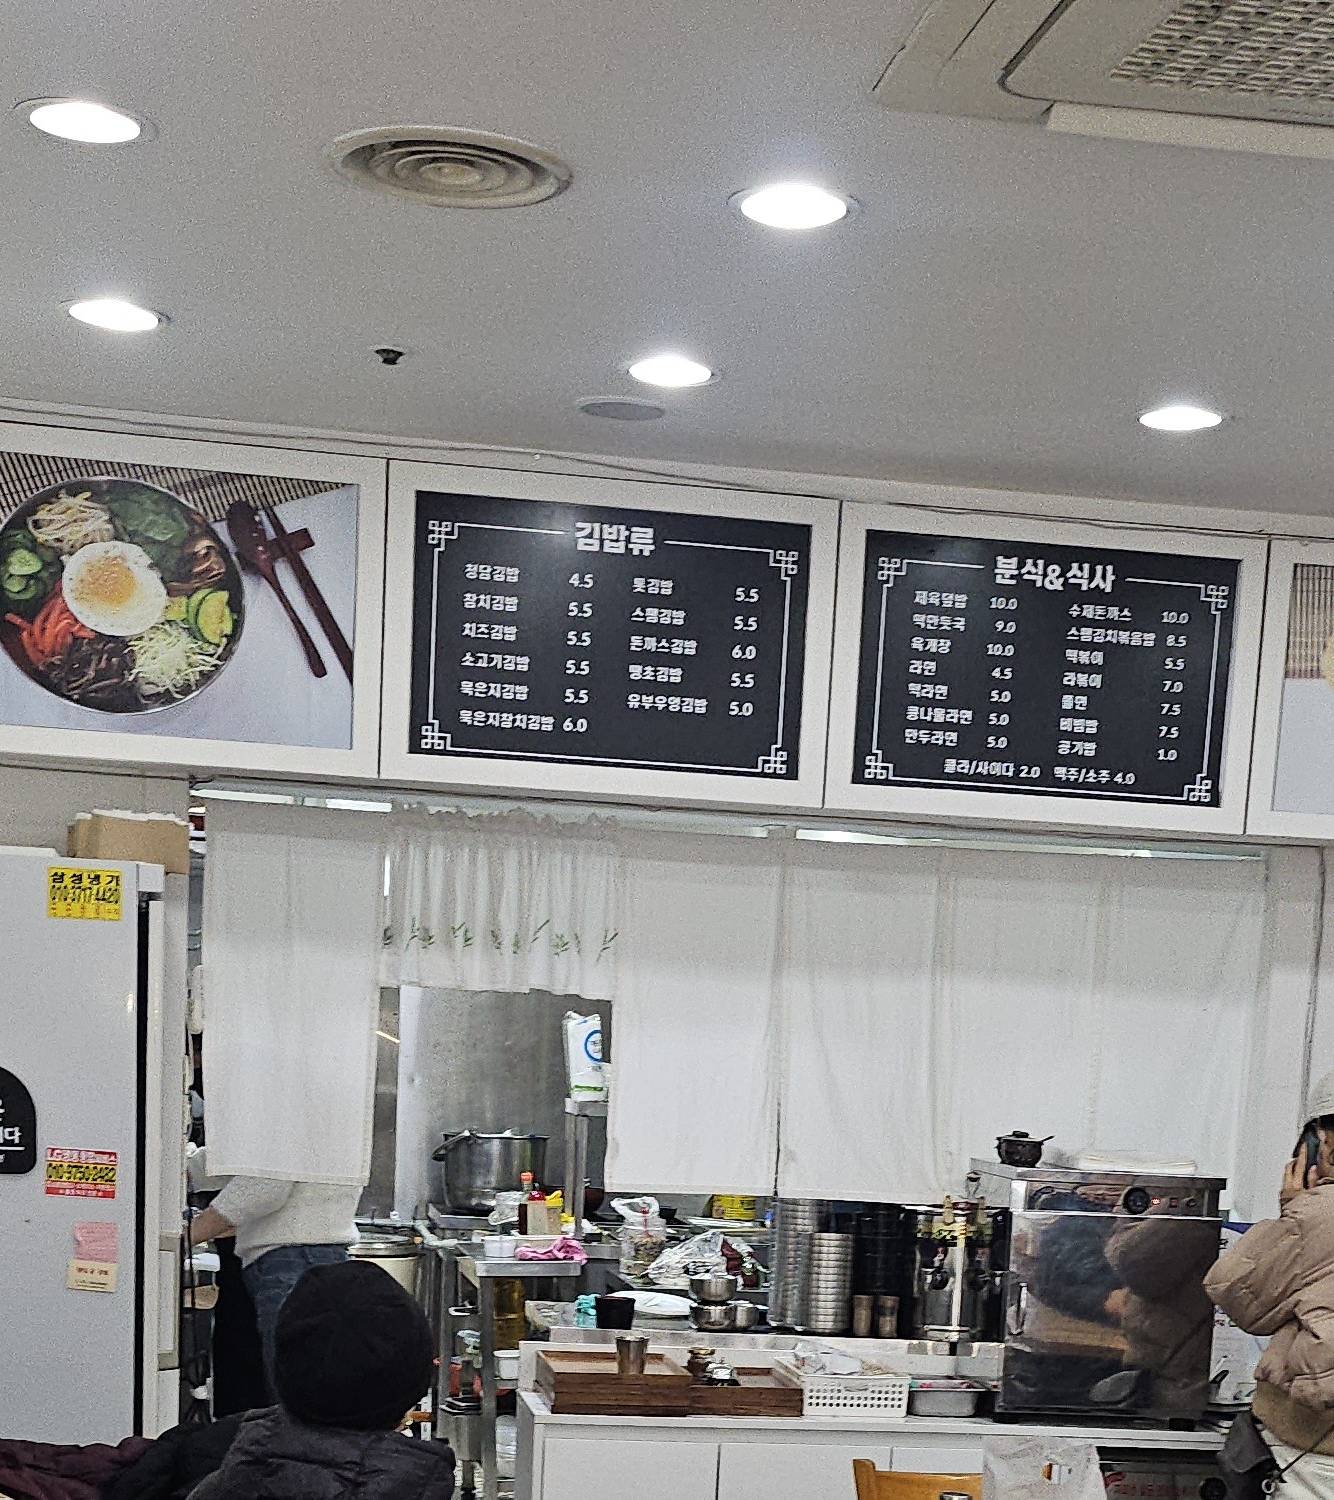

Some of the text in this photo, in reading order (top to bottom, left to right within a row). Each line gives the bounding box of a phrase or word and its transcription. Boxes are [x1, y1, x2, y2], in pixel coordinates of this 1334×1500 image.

[574, 521, 656, 556] 김밥류
[465, 564, 593, 588] 청담김밥 4.5
[995, 556, 1115, 592] 분식&식사
[735, 588, 759, 602] 5.5
[990, 597, 1017, 609] 10.0
[464, 593, 592, 617] 참치김밥 5.5
[631, 607, 757, 630] 스팸김밥 5.5
[995, 621, 1016, 633] 9.0
[1162, 612, 1188, 623] 10.0
[462, 623, 591, 646] 치즈김밥 5.5
[1167, 635, 1186, 647] 8.5
[630, 636, 756, 659] 돈까스김밥 6.0
[911, 637, 1014, 656] 육개장 10.0
[461, 652, 589, 675] 소고기김밥 5.5
[909, 660, 1012, 679] 라면 4.5
[1165, 658, 1185, 670] 5.5
[731, 673, 754, 687] 5.5
[1163, 681, 1183, 692] 7.0
[460, 681, 588, 703] 묵은지김밥 5.5
[990, 690, 1011, 702] 5.0
[627, 694, 753, 716] 유부우엉김밥 5.0
[1161, 704, 1181, 715] 7.5
[459, 710, 587, 732] 묵은지참치김밥 6.0
[906, 706, 1009, 725] 콩나물라면 5.0
[1060, 718, 1178, 738] 비빔밥 7.5
[905, 729, 1007, 748] 만두라면 5.0
[1058, 740, 1177, 760] 공기밥 1.0
[1019, 766, 1040, 778] 2.0
[1113, 773, 1135, 784] 4.0
